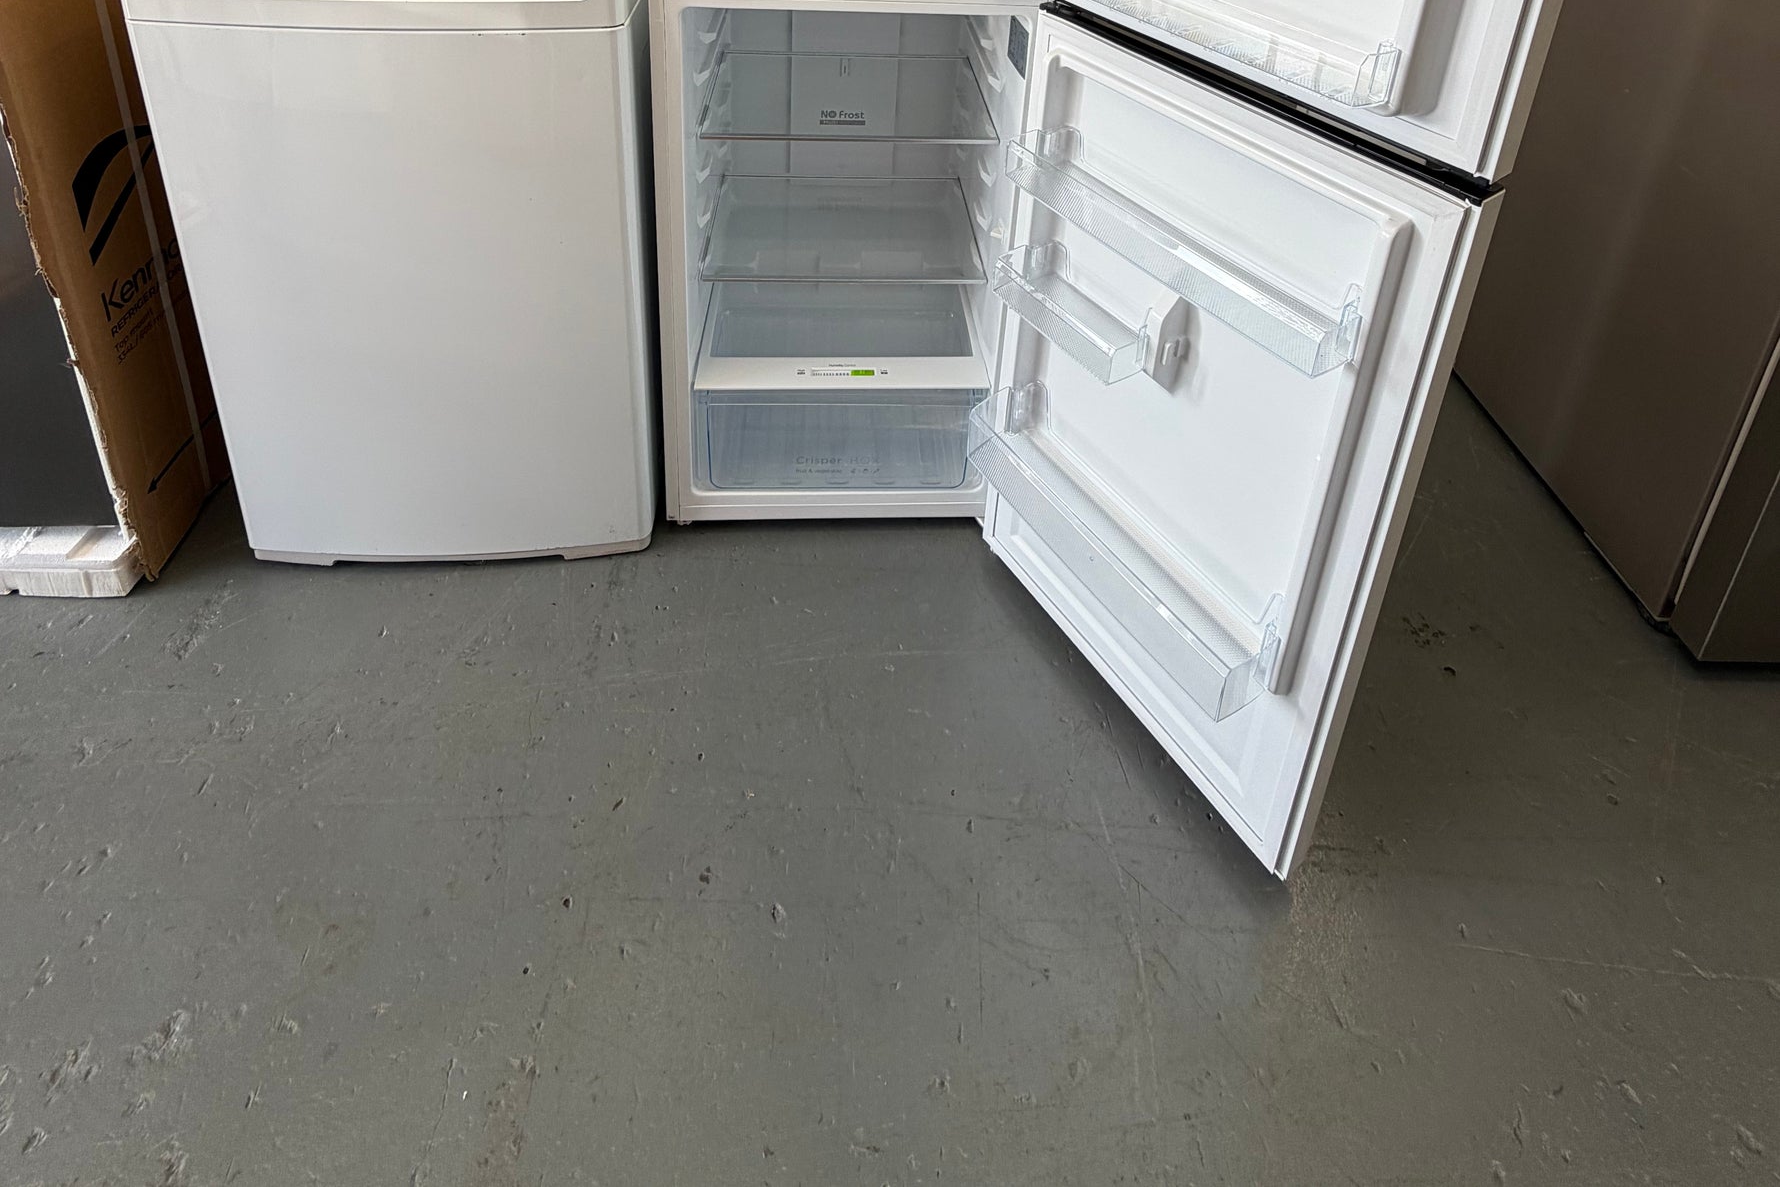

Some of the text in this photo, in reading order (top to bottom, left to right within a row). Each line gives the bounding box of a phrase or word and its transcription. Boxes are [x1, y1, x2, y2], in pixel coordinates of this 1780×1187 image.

[820, 109, 865, 119] NO Frost
[796, 455, 842, 465] Crisper
